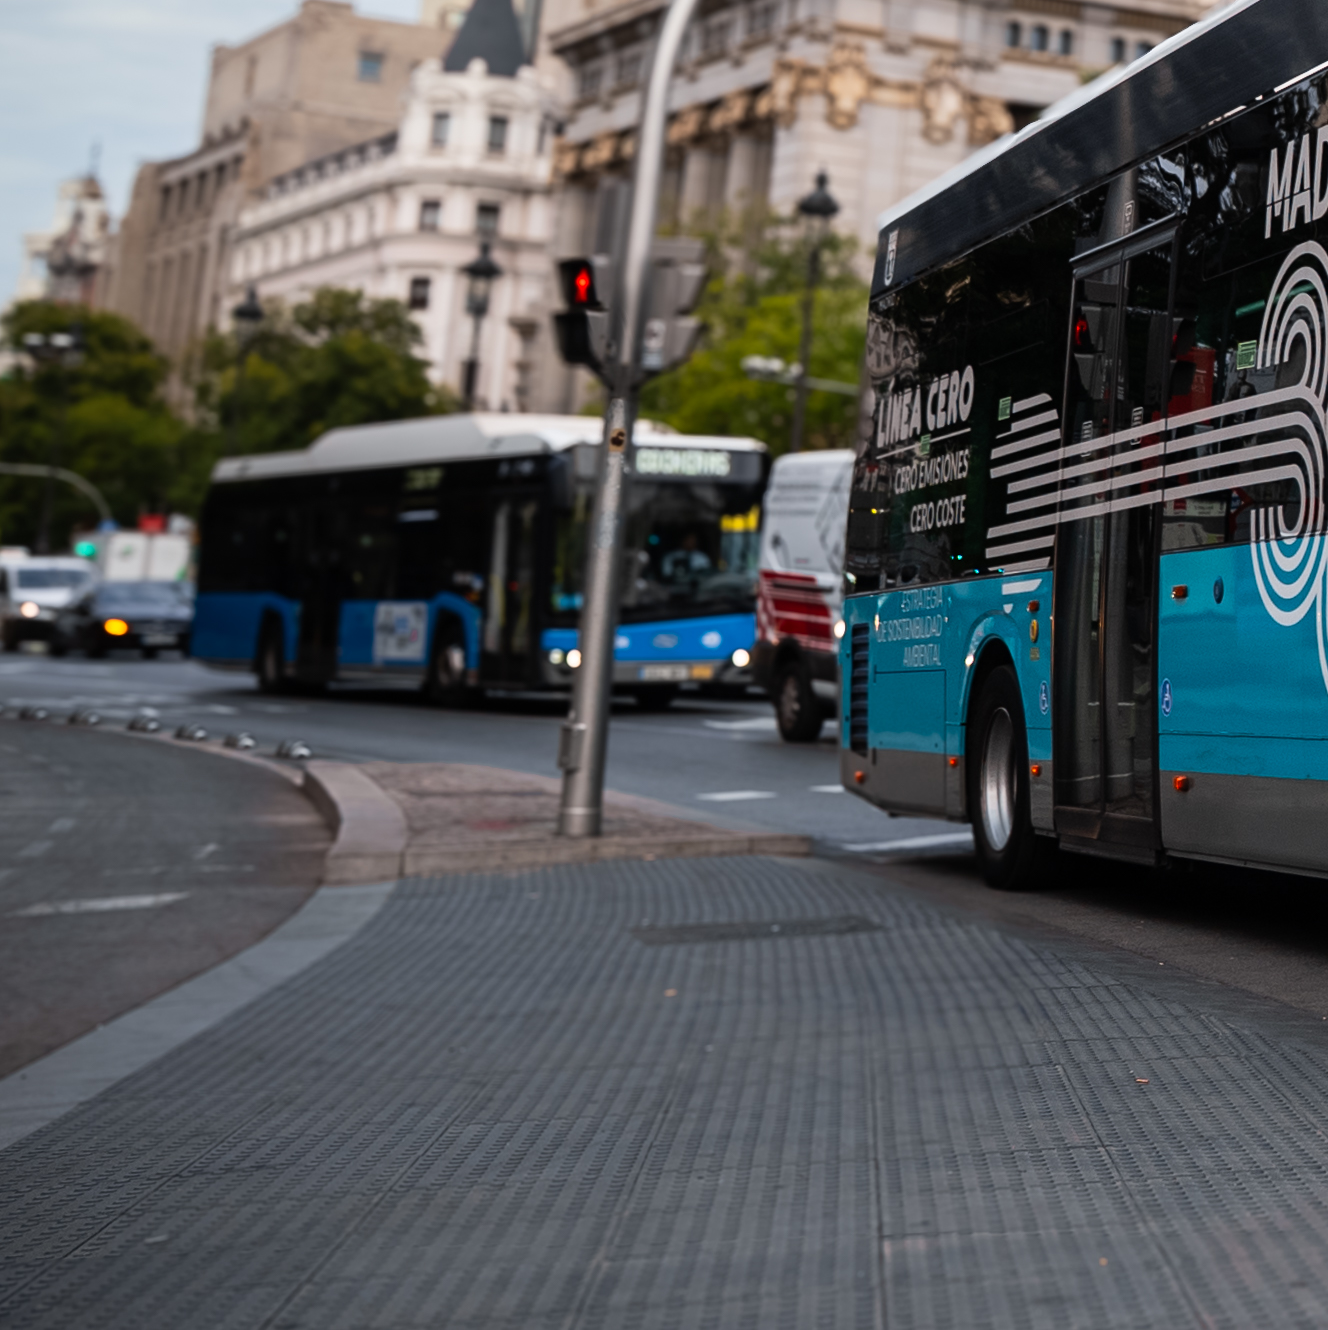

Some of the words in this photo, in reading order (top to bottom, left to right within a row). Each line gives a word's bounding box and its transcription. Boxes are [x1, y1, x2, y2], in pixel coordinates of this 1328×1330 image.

[877, 376, 922, 449] LÍNEA
[926, 365, 975, 432] CERO
[894, 465, 918, 495] CERO
[918, 448, 970, 488] EMISIONES
[910, 501, 935, 533] CERO
[936, 494, 967, 529] COSTE
